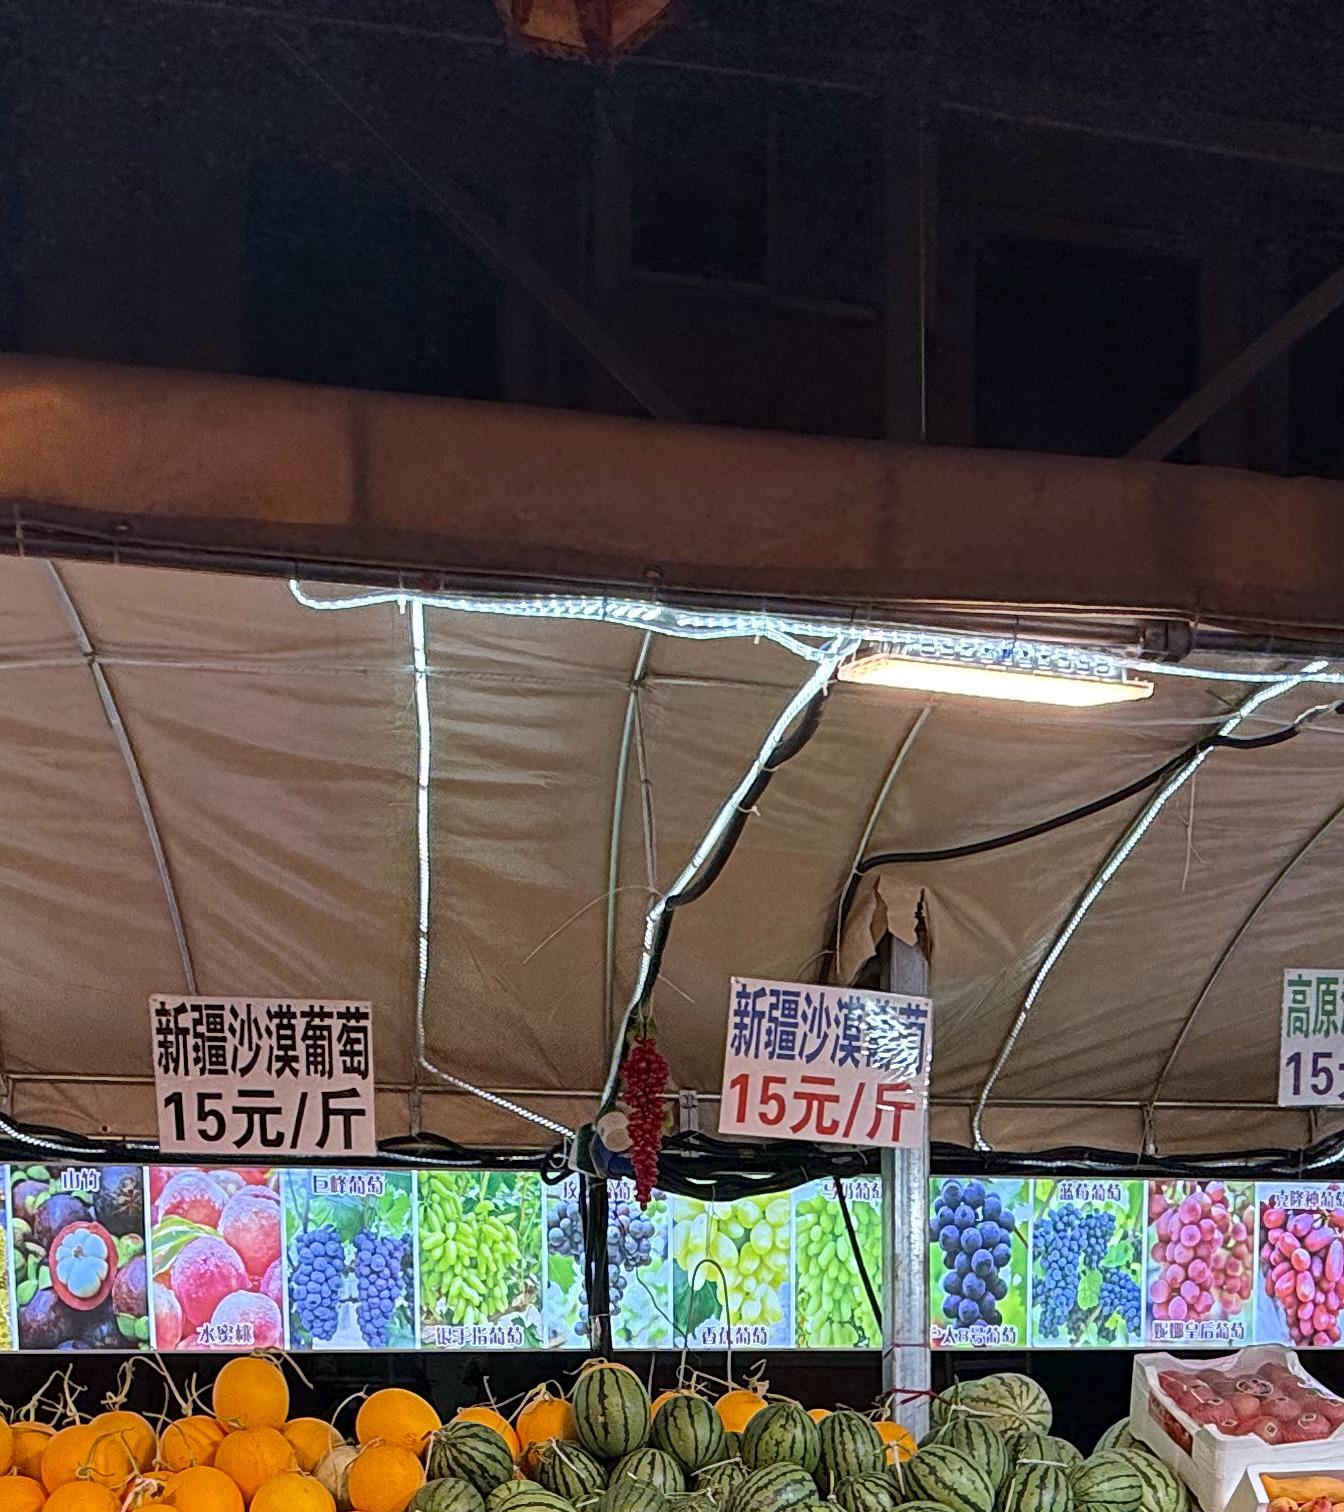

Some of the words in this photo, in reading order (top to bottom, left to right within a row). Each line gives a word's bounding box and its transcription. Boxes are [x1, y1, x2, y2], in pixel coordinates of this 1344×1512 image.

[155, 1001, 370, 1080] 新疆沙漠葡萄
[164, 1087, 367, 1149] 15元/斤
[729, 1073, 916, 1142] 15元/斤
[62, 1169, 98, 1190] 山竹
